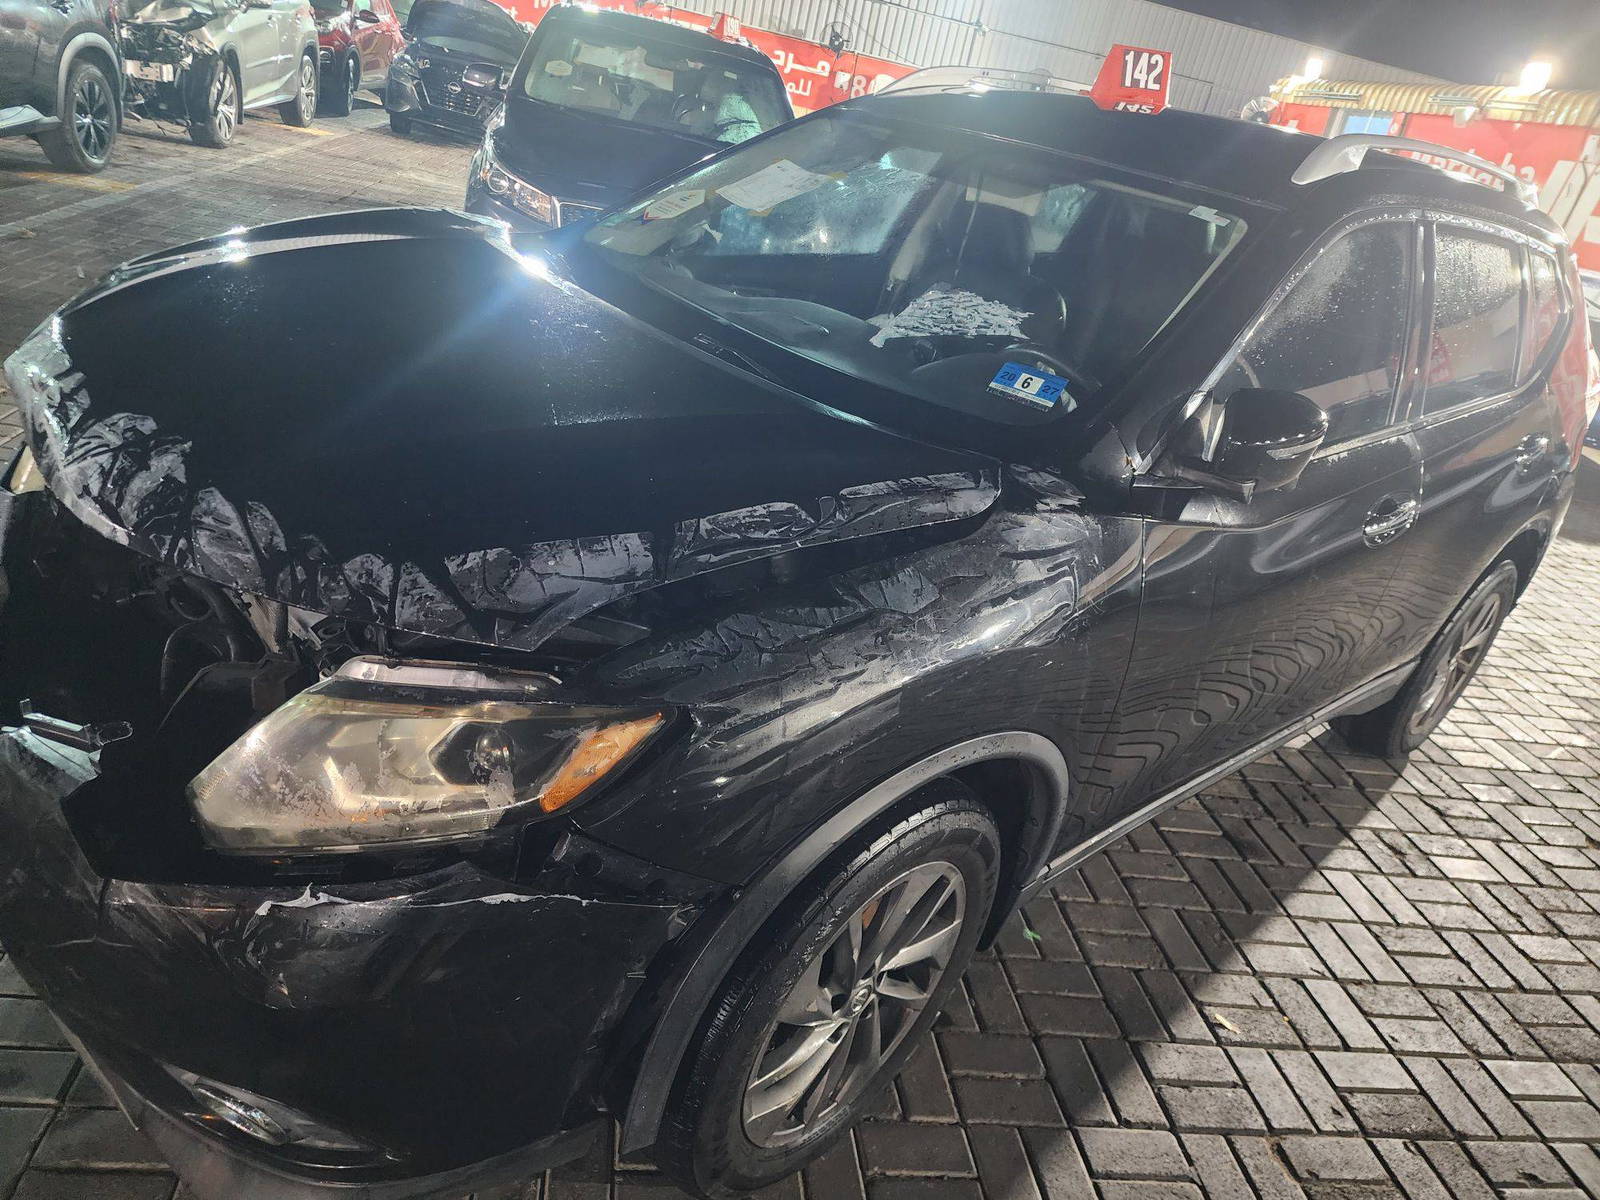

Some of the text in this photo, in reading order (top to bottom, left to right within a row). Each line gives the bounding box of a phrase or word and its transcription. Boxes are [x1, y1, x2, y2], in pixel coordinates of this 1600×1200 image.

[1125, 50, 1164, 91] 142
[1000, 371, 1017, 382] 20
[1021, 376, 1034, 390] 6
[1042, 384, 1060, 396] 27
